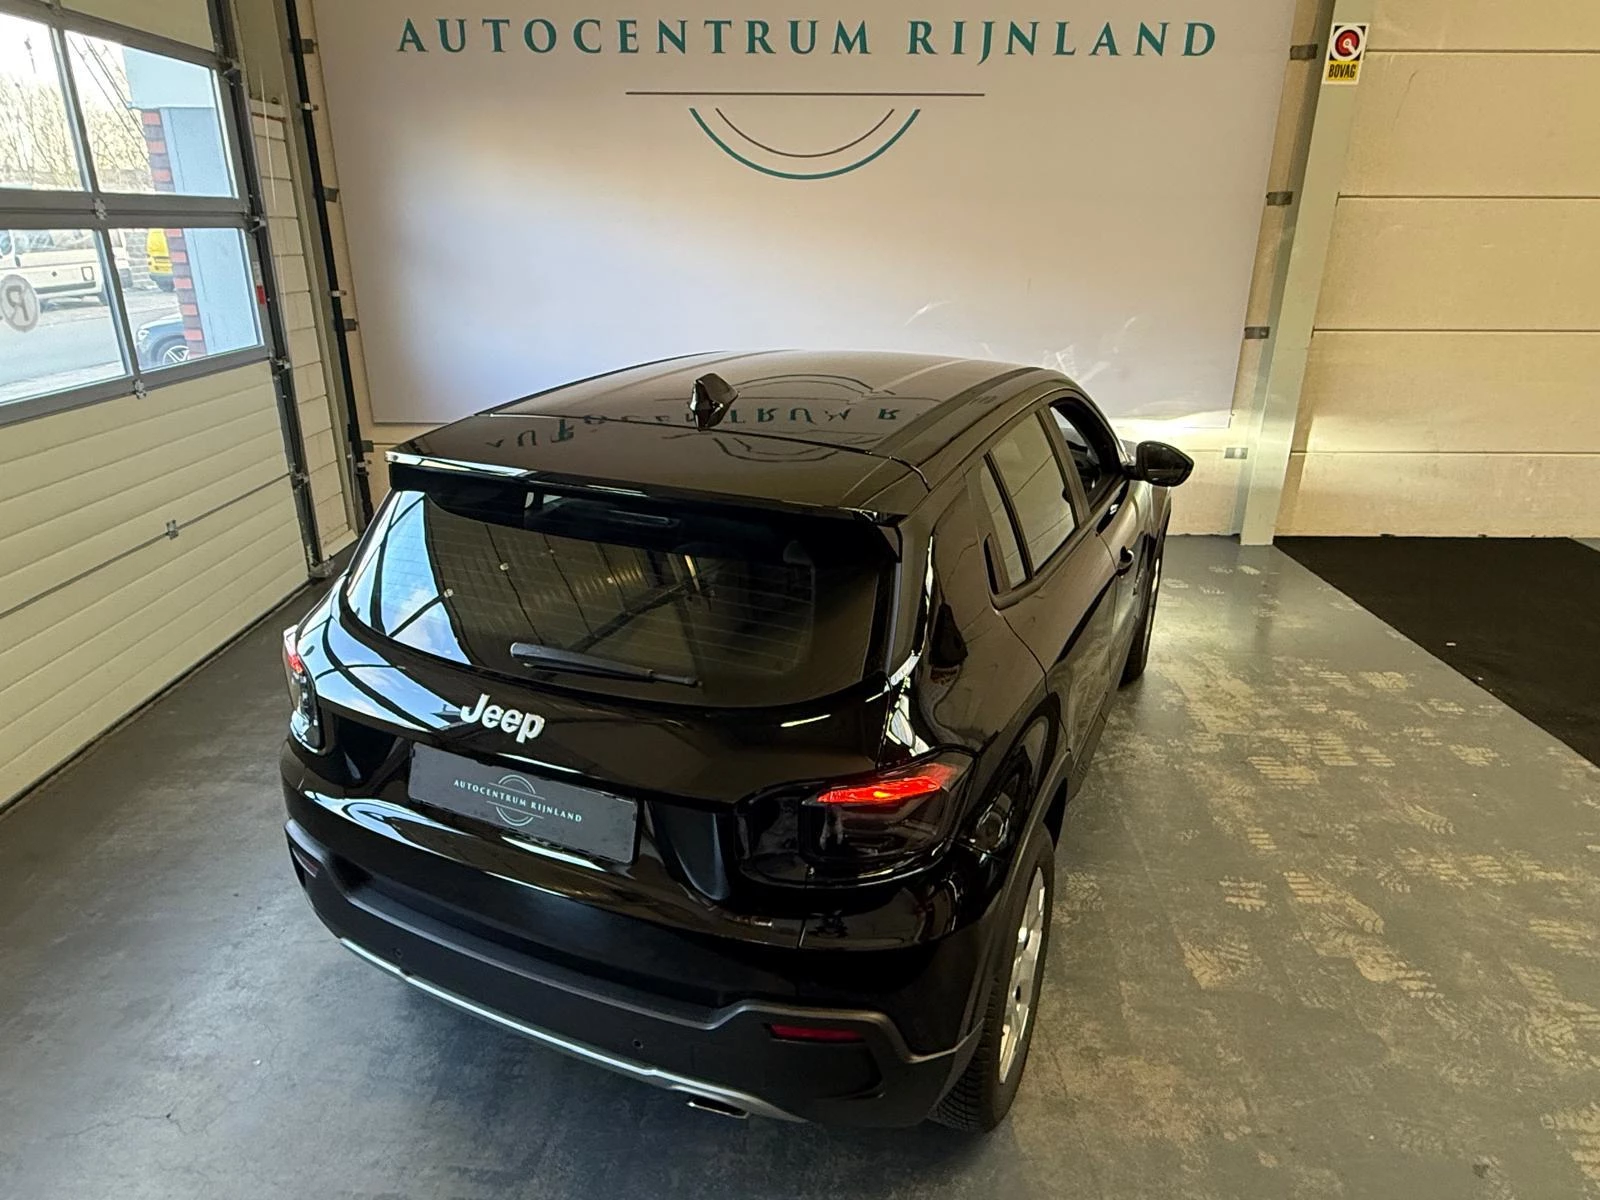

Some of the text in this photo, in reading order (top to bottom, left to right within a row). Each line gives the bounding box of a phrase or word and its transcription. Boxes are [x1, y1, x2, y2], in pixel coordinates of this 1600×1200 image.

[396, 18, 1217, 65] AUTOCENTRUM RIJNLAND
[1328, 64, 1357, 78] BOVAG
[459, 693, 546, 744] Jeep
[453, 779, 583, 823] AUTOCENTRUM RIJNLAND
